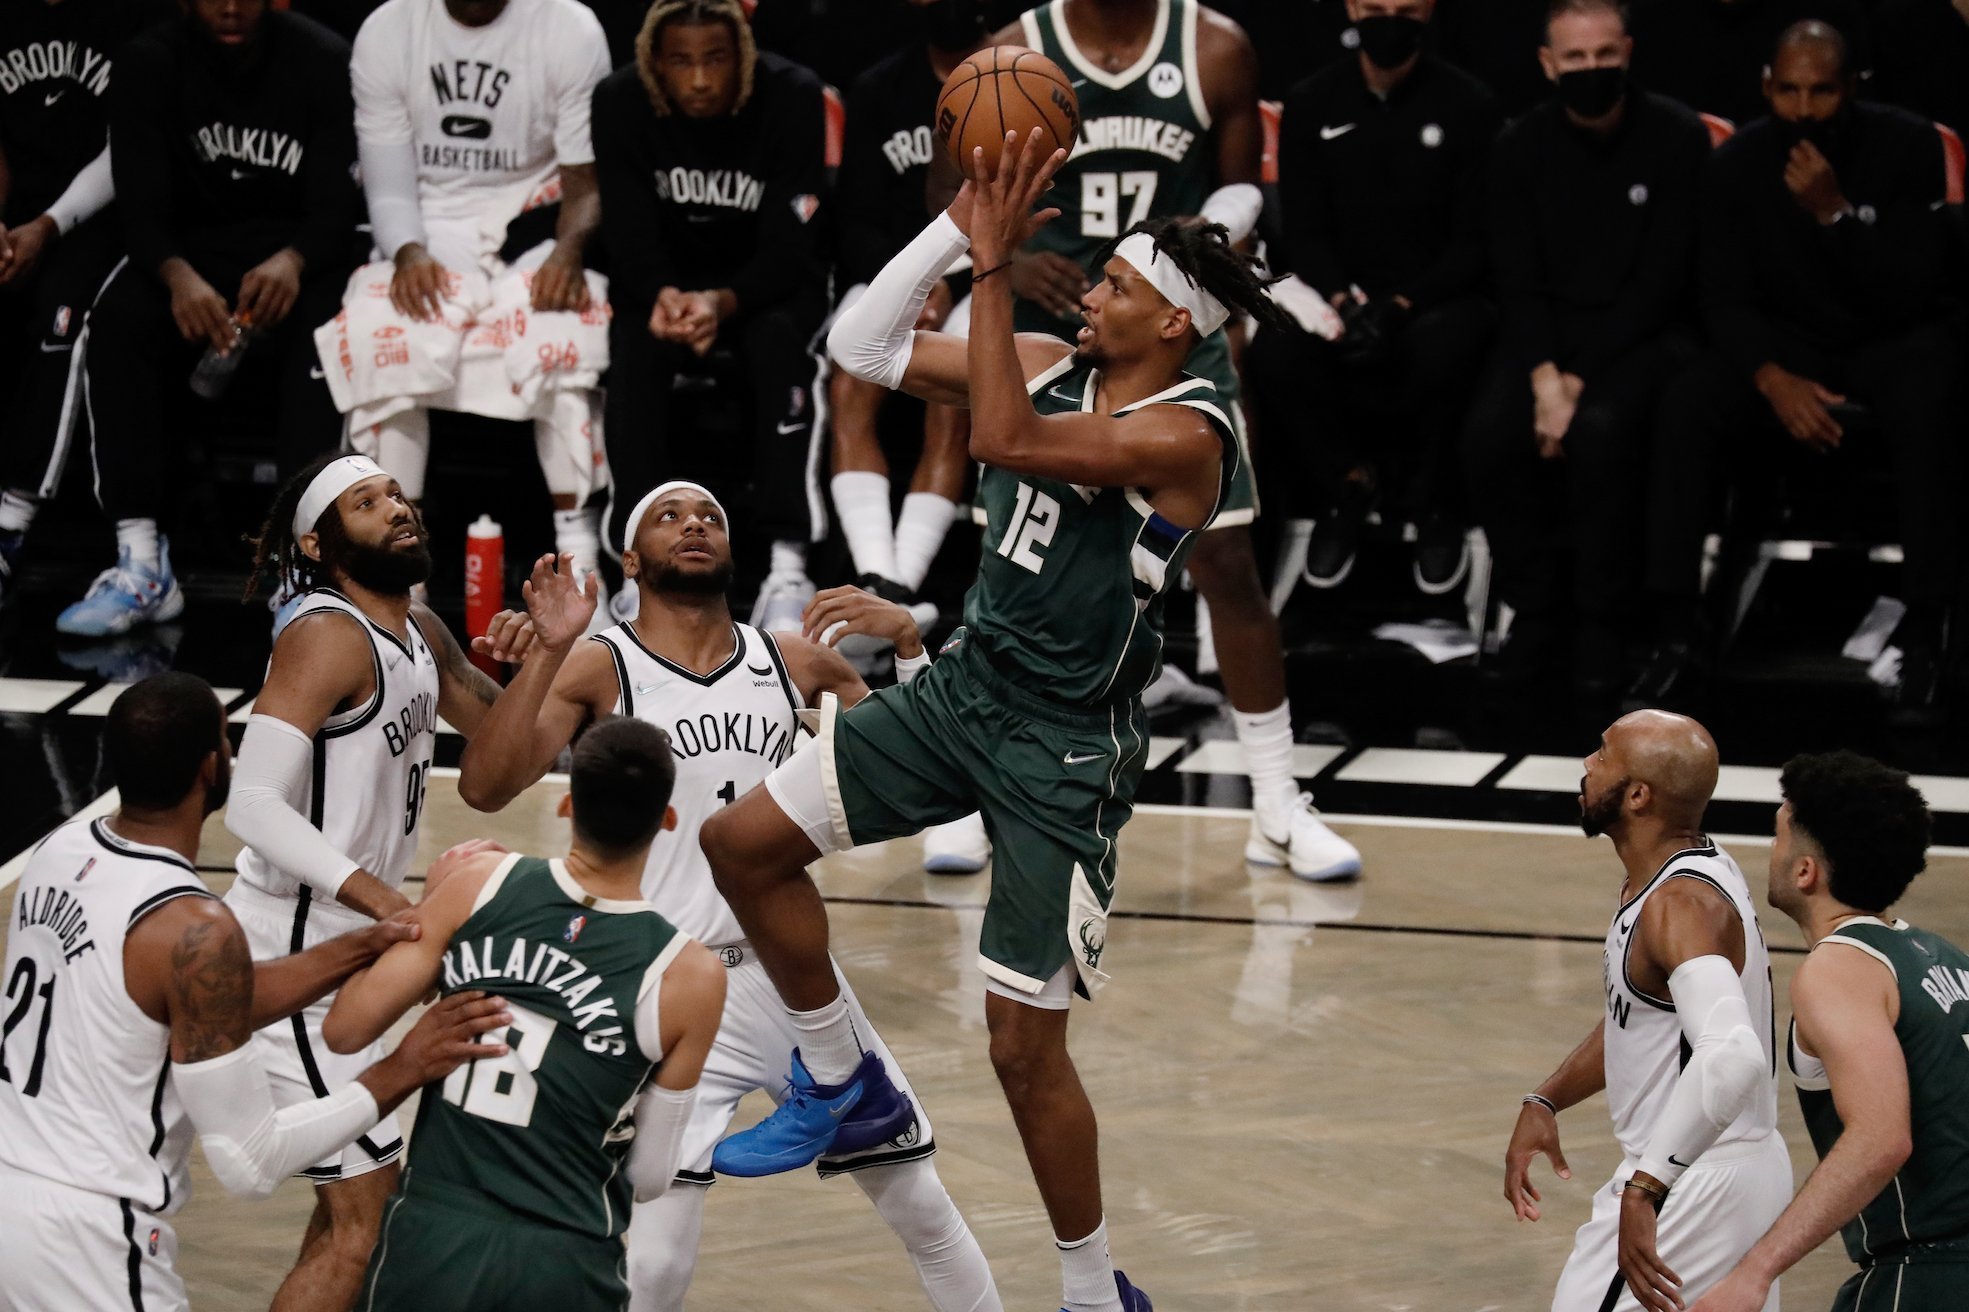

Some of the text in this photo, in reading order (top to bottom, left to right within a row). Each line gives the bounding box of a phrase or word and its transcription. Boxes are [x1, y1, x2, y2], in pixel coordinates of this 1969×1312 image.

[430, 60, 511, 108] NETS
[191, 121, 304, 175] ROOKLYN
[422, 144, 521, 172] BASKETBALL
[1080, 170, 1158, 238] 97
[997, 481, 1061, 575] 12
[752, 680, 780, 688] Webull
[671, 712, 791, 769] OOKLYN
[19, 886, 96, 966] ALDRIDGE
[0, 956, 57, 1098] 21
[442, 935, 627, 1057] KALAITZAKIS
[442, 1002, 559, 1128] 18
